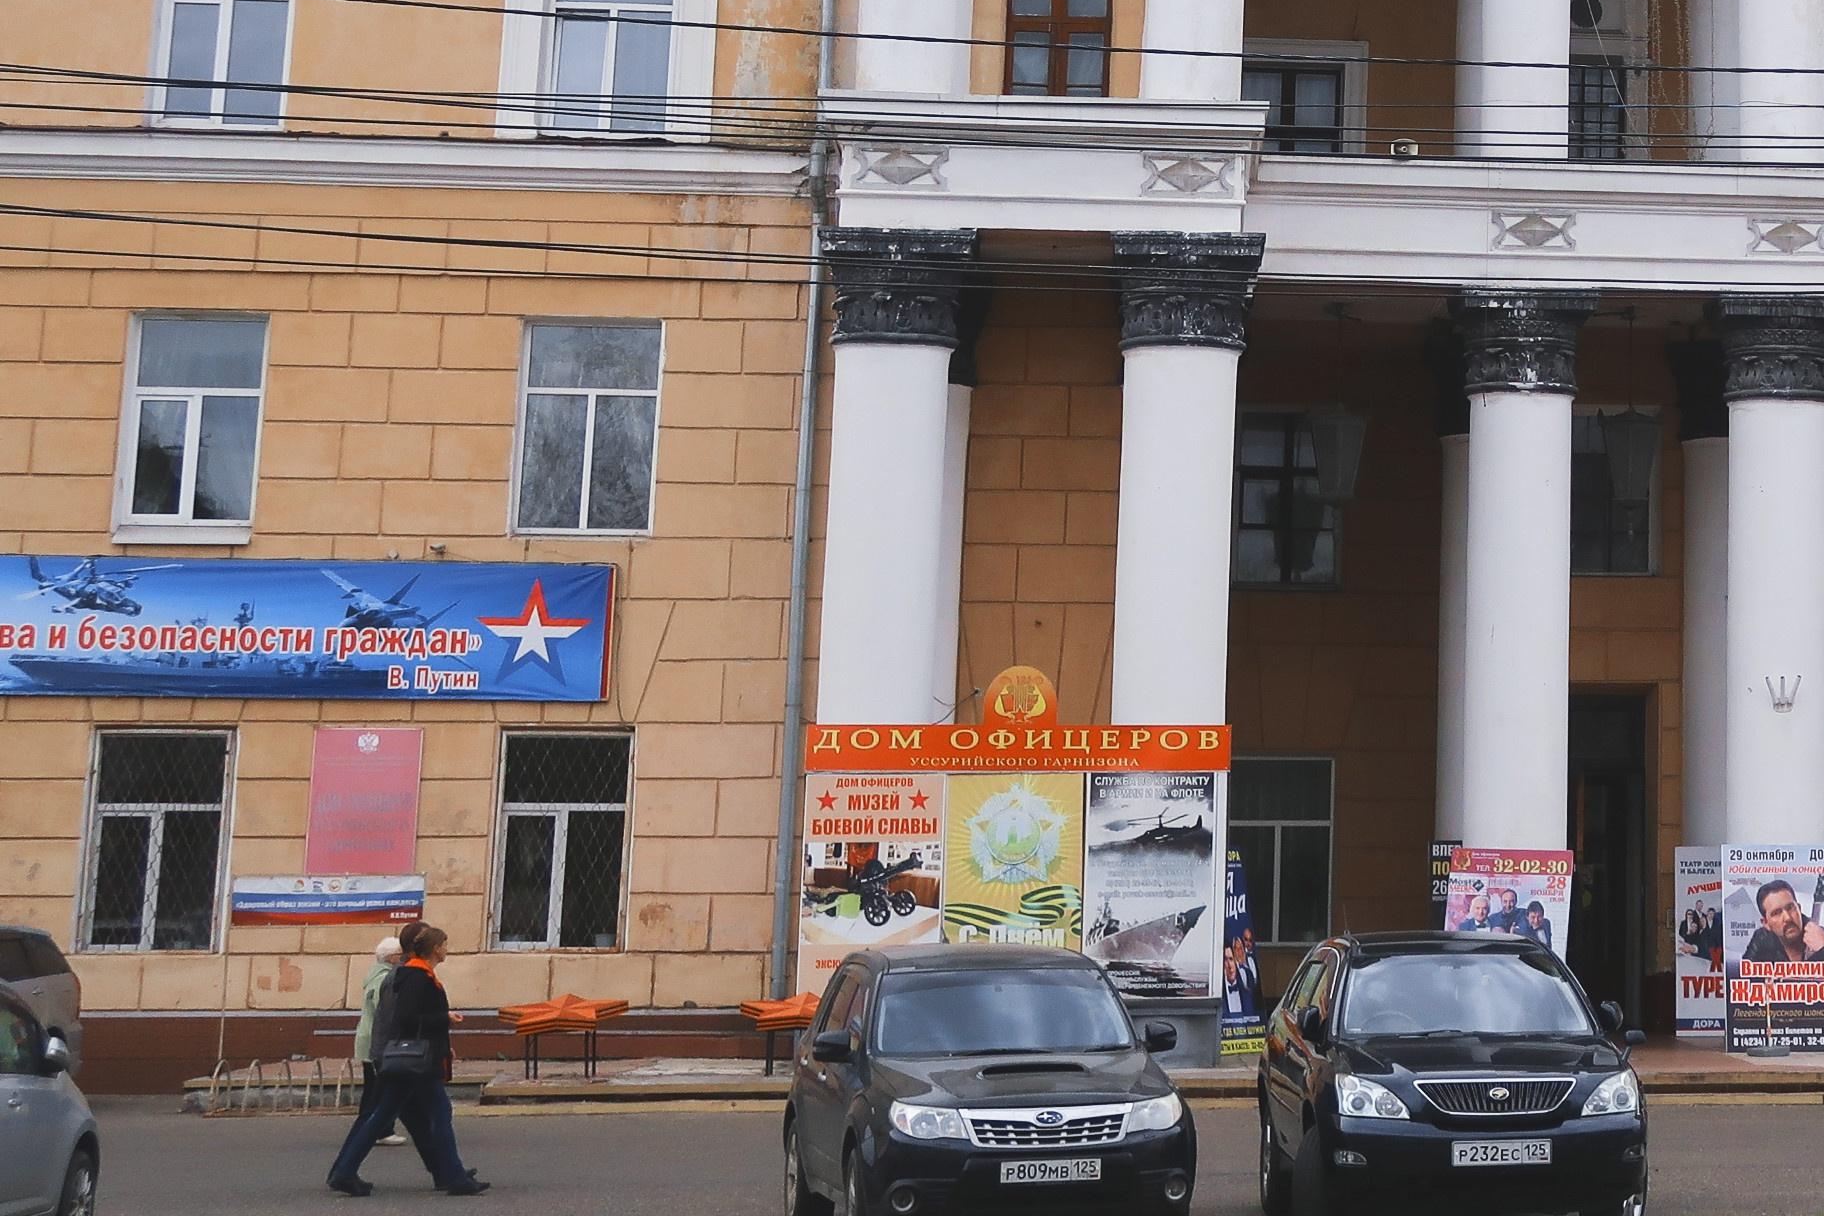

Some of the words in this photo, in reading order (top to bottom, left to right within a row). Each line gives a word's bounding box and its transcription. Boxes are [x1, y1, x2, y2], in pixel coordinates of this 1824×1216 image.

[48, 624, 67, 650] и
[77, 615, 312, 653] безопасности
[324, 626, 483, 660] граждан»
[388, 666, 409, 689] В.
[415, 666, 479, 693] Путин
[812, 728, 923, 754] ДОМ
[950, 728, 1221, 754] ОФИЦЕРОВ
[910, 754, 1038, 767] УССУРИЙСКОГО
[1043, 755, 1140, 767] ГАРНИЗОНА
[836, 778, 859, 789] ДОМ
[861, 777, 914, 788] ОФИЦЕРОВ
[848, 790, 900, 811] МУЗЕЙ
[1171, 789, 1205, 798] ФЛОТЕ
[812, 815, 874, 836] БОЕВОЙ
[878, 817, 937, 834] СЛАВЫ
[1730, 849, 1743, 861] 29
[1746, 849, 1795, 862] октября
[1493, 857, 1568, 875] 32-02-30
[1432, 880, 1448, 895] 26
[1546, 876, 1567, 890] 28
[1692, 1020, 1721, 1029] ДОРА
[1459, 1145, 1520, 1162] Р232ЕС
[1524, 1143, 1546, 1156] 125
[1006, 1163, 1069, 1180] Р809МВ
[1073, 1160, 1097, 1174] 125
